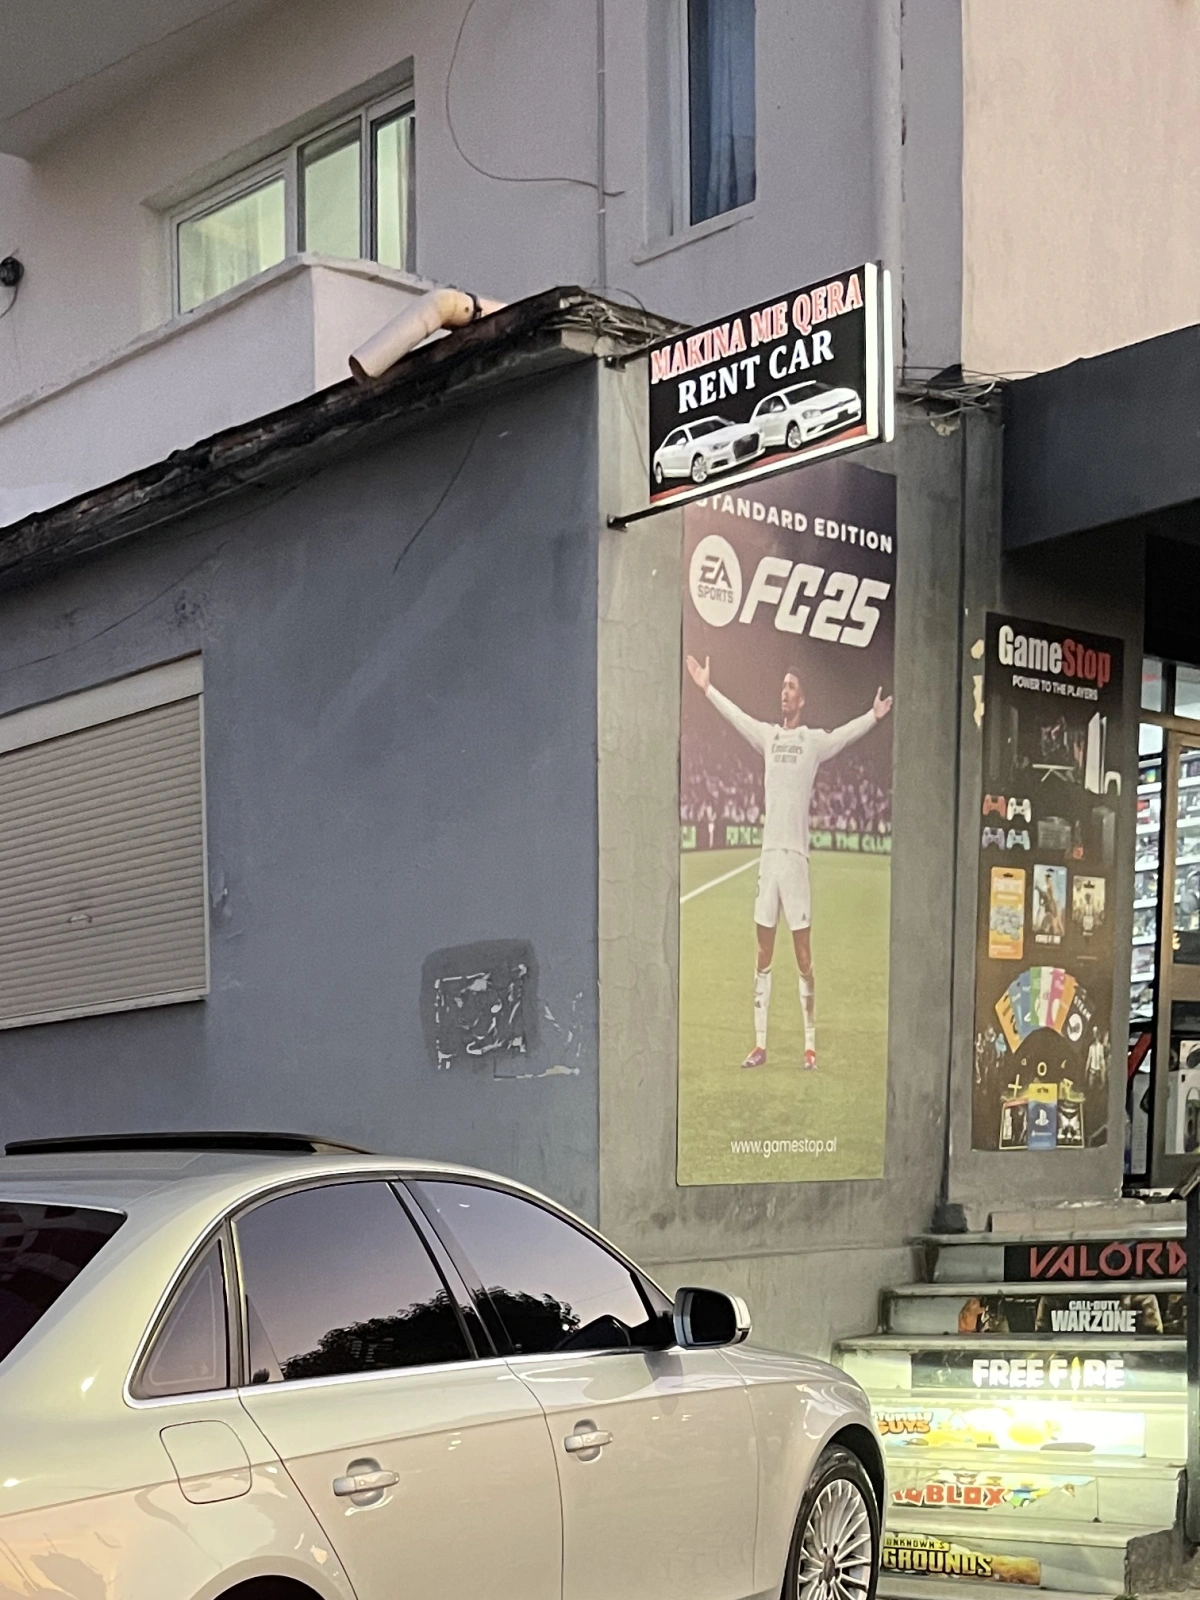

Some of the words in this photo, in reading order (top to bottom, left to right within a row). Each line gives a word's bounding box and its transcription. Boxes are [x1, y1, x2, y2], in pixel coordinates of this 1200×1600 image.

[650, 318, 748, 385] MAKINA
[749, 301, 789, 348] ME
[792, 273, 864, 336] QERA
[677, 354, 761, 414] RENT
[768, 329, 835, 380] CAR
[813, 517, 893, 554] EDITION
[699, 554, 733, 589] EA
[697, 584, 734, 604] SPORTS
[998, 624, 1111, 688] GameStop
[1012, 674, 1040, 691] POWER
[1041, 680, 1052, 693] TO
[1052, 682, 1067, 696] THE
[1066, 684, 1099, 701] PLAYERS
[730, 1136, 838, 1158] www.gamestop.al
[1051, 1310, 1137, 1332] WARZONE
[972, 1358, 1045, 1388] FREE
[1048, 1356, 1125, 1390] FIRE
[882, 1547, 993, 1577] GROUNDS
